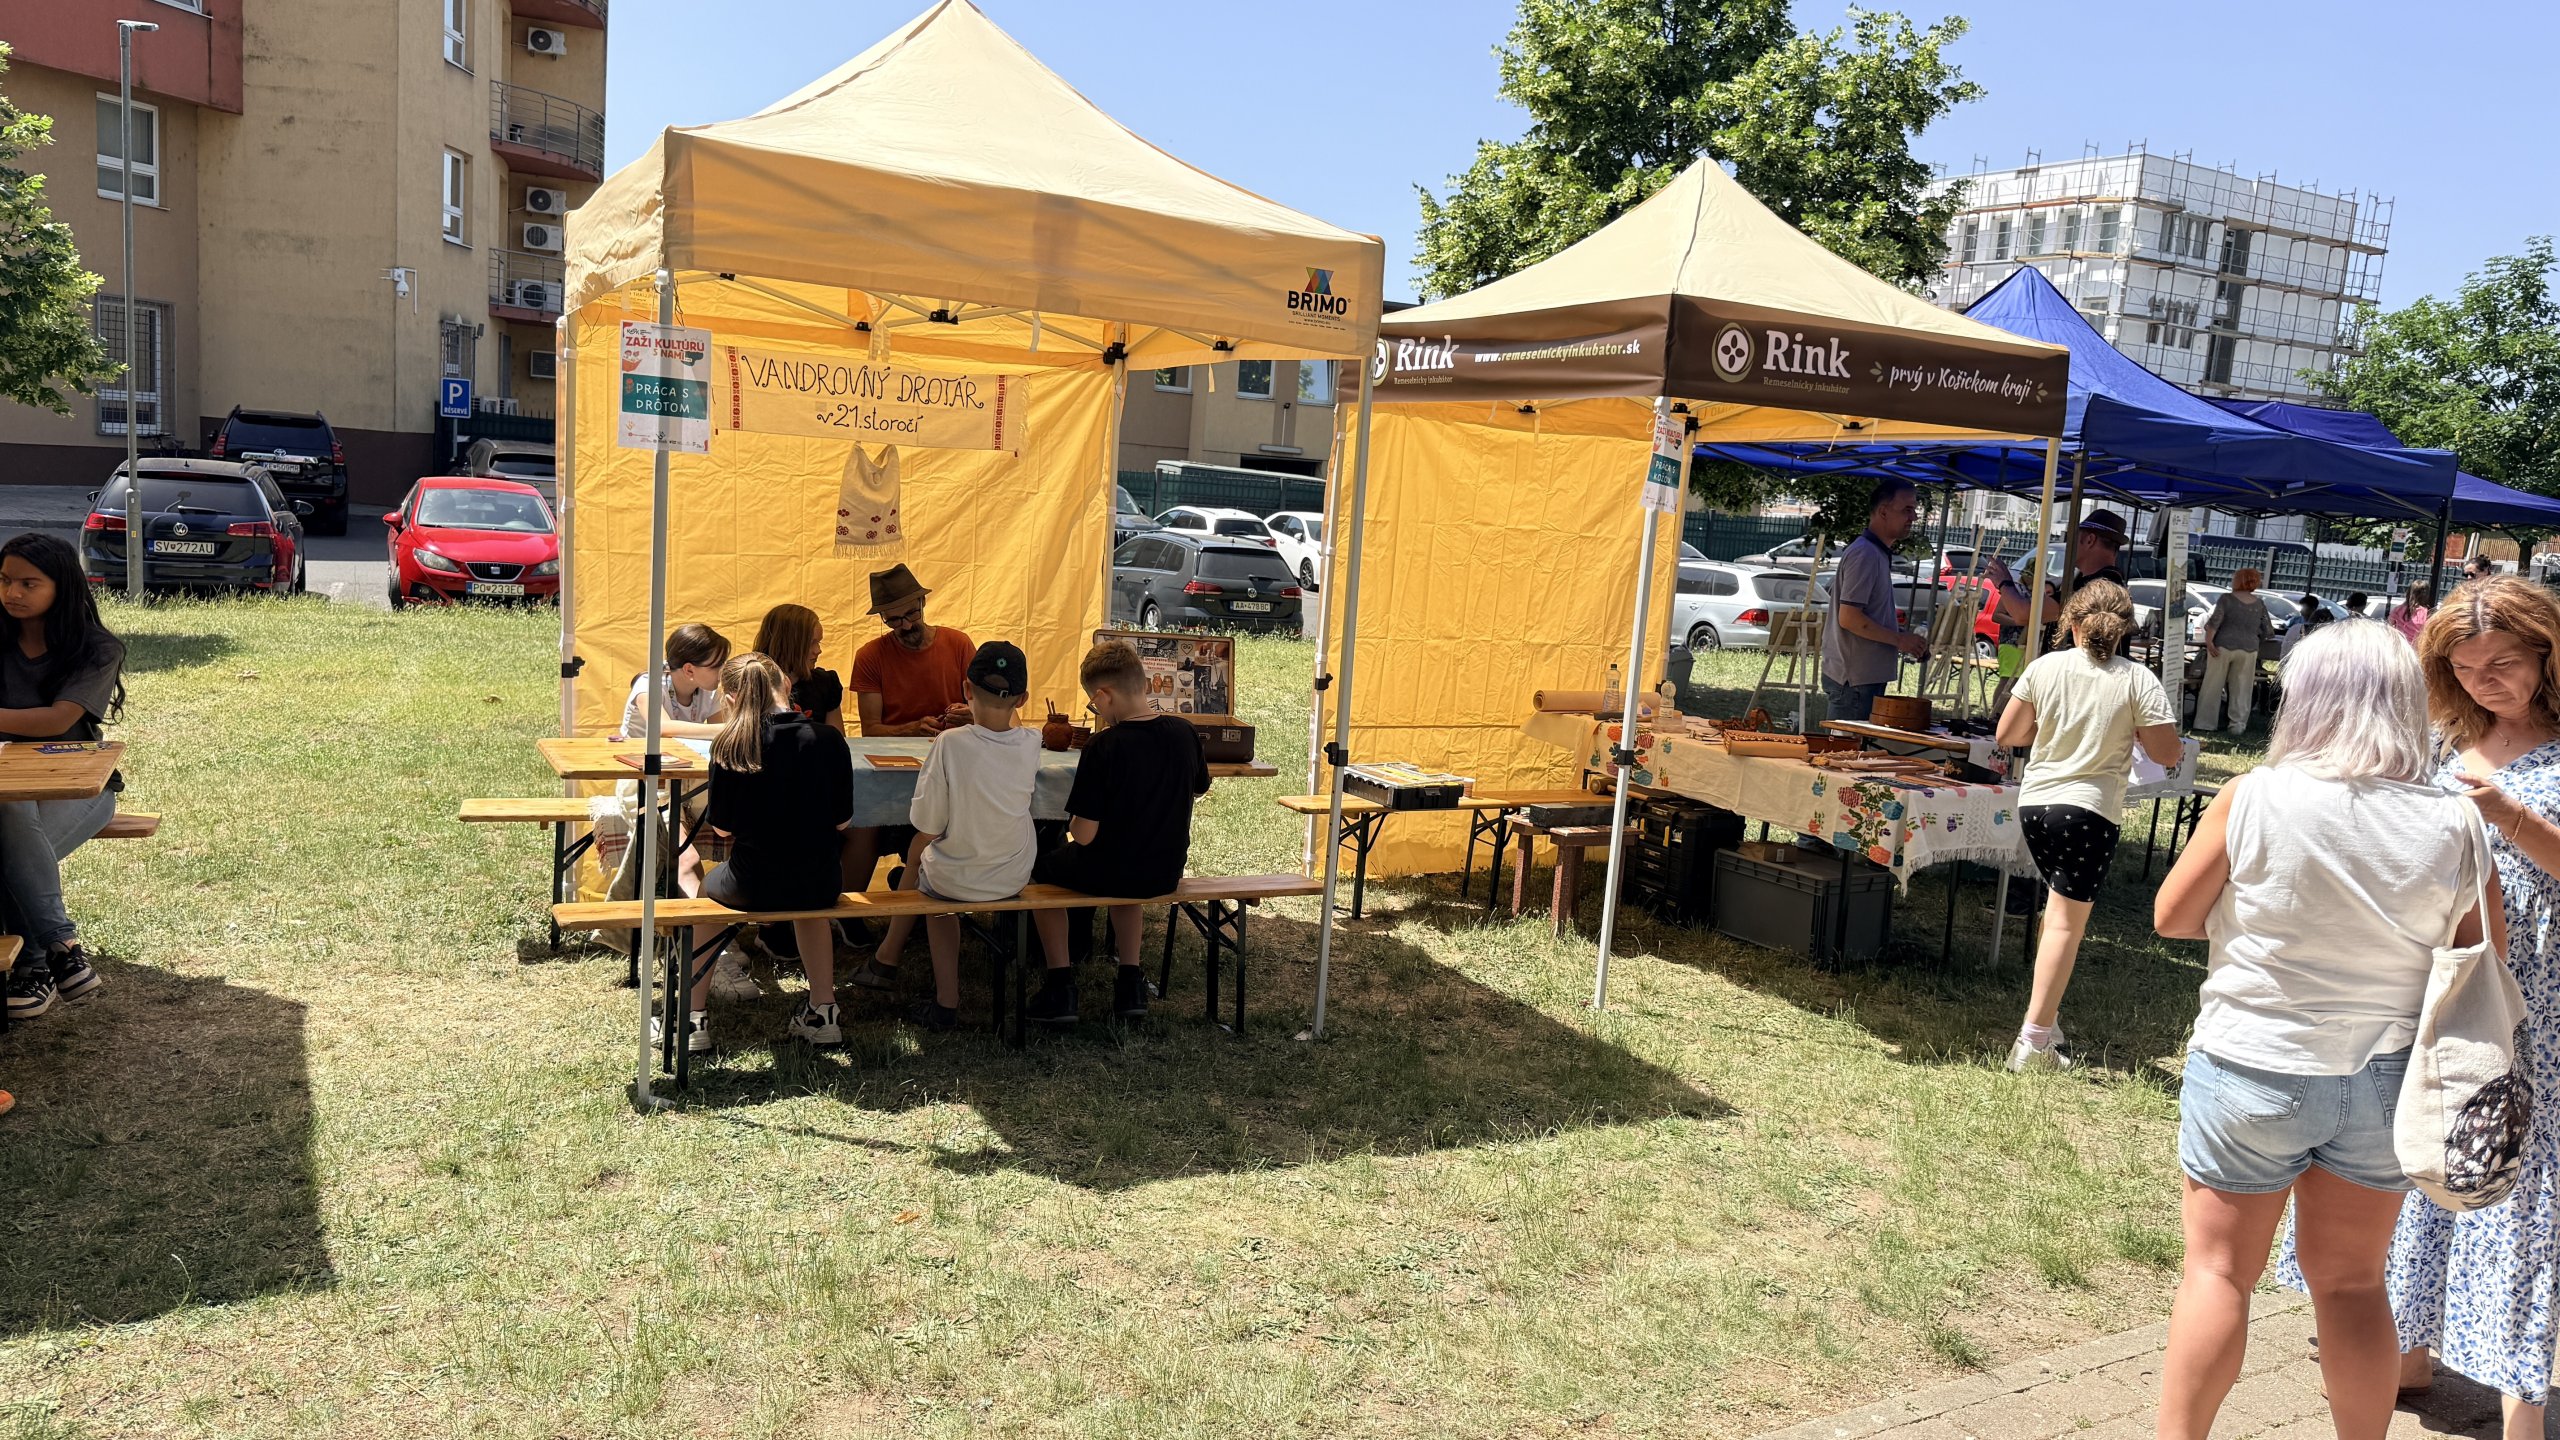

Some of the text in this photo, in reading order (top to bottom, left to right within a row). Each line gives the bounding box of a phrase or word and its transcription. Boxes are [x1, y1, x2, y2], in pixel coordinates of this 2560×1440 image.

[1287, 290, 1347, 315] BRIMO
[625, 336, 705, 352] ZAŽI KULTÚRU
[1394, 334, 1460, 371] Rink
[1474, 338, 1641, 363] www.remeselnickyinkubator.sk
[1762, 329, 1851, 379] Rink
[449, 383, 463, 405] P
[636, 382, 689, 398] PRÁCA S
[741, 355, 985, 409] VANDROVNÝ DROTÁR
[1888, 365, 2033, 405] prvý v Košickom kraji
[636, 398, 690, 413] DRÔTOM
